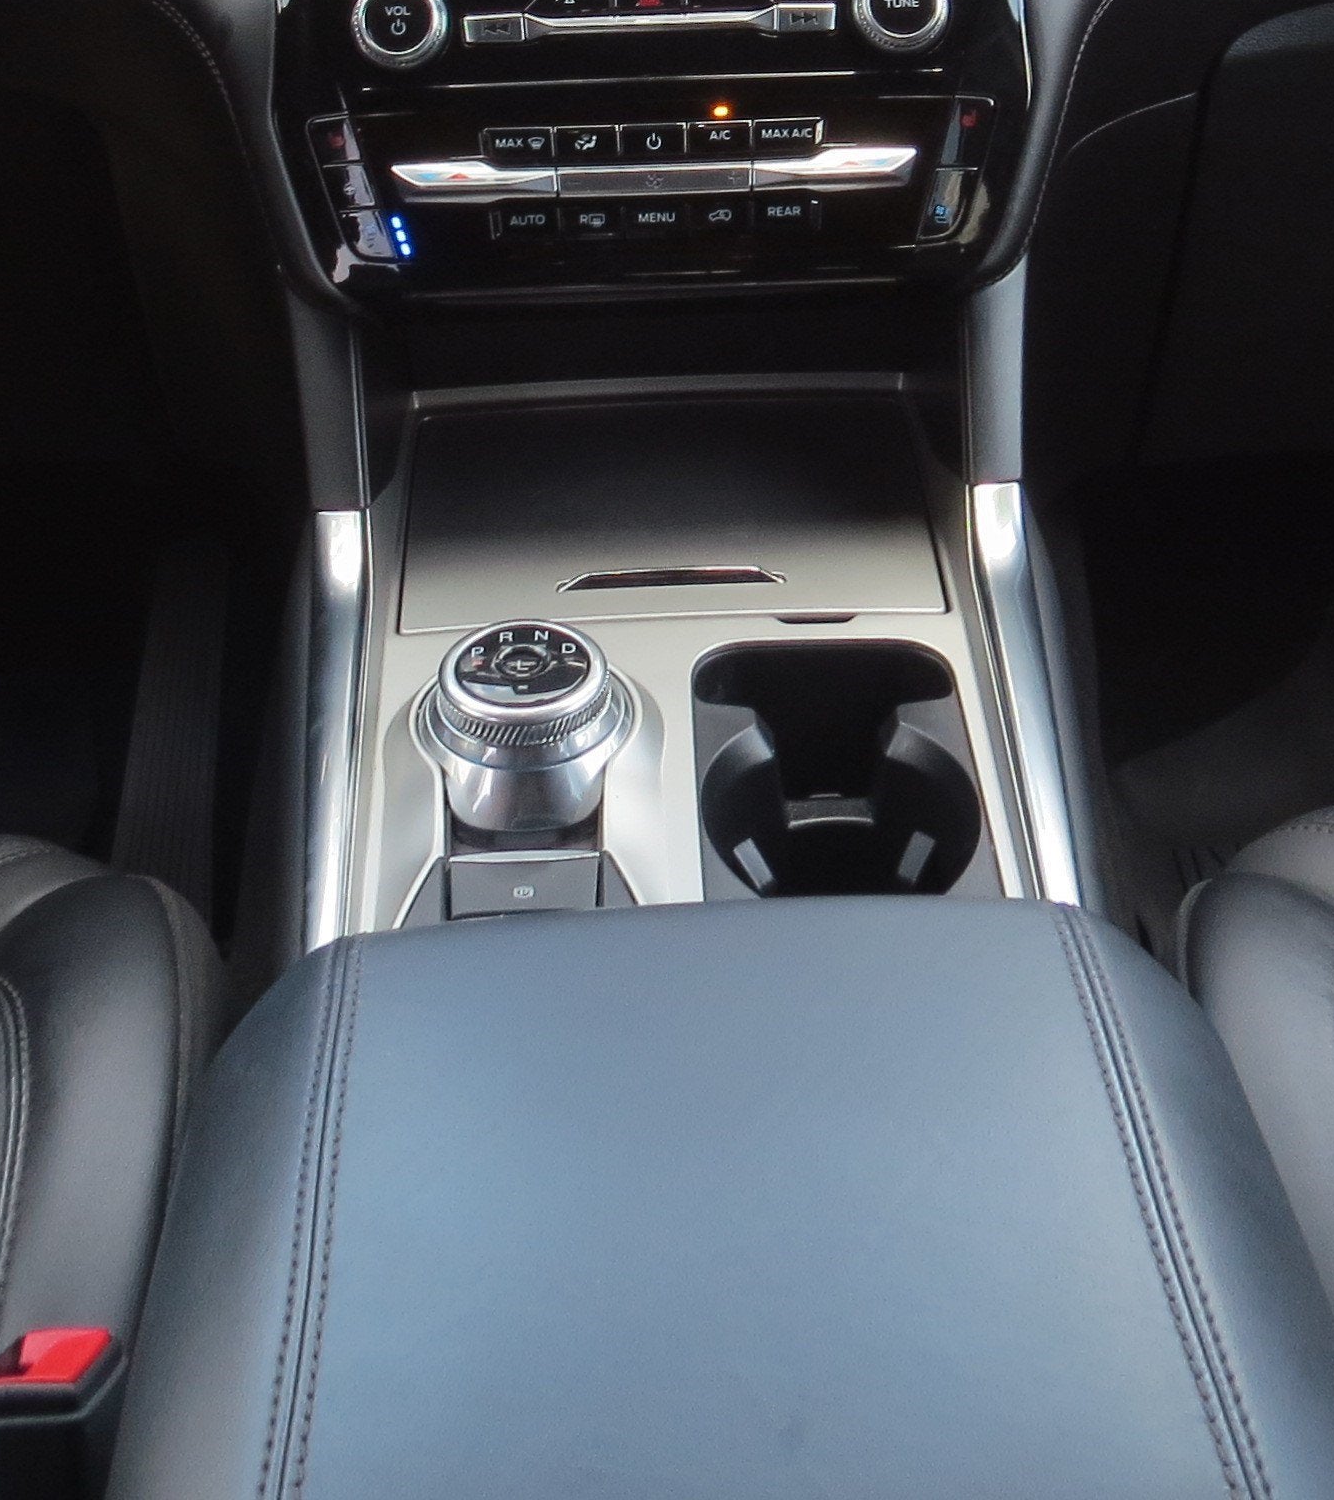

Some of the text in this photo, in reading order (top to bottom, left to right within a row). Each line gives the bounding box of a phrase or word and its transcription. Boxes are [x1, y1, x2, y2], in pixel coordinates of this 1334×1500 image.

[385, 5, 411, 16] VOL
[709, 129, 731, 142] A/C
[761, 126, 813, 139] MAX A/C
[496, 138, 523, 148] MAX
[767, 205, 801, 217] REAR
[510, 214, 545, 226] AUTO
[638, 212, 675, 223] MENU
[471, 630, 577, 658] P R N D
